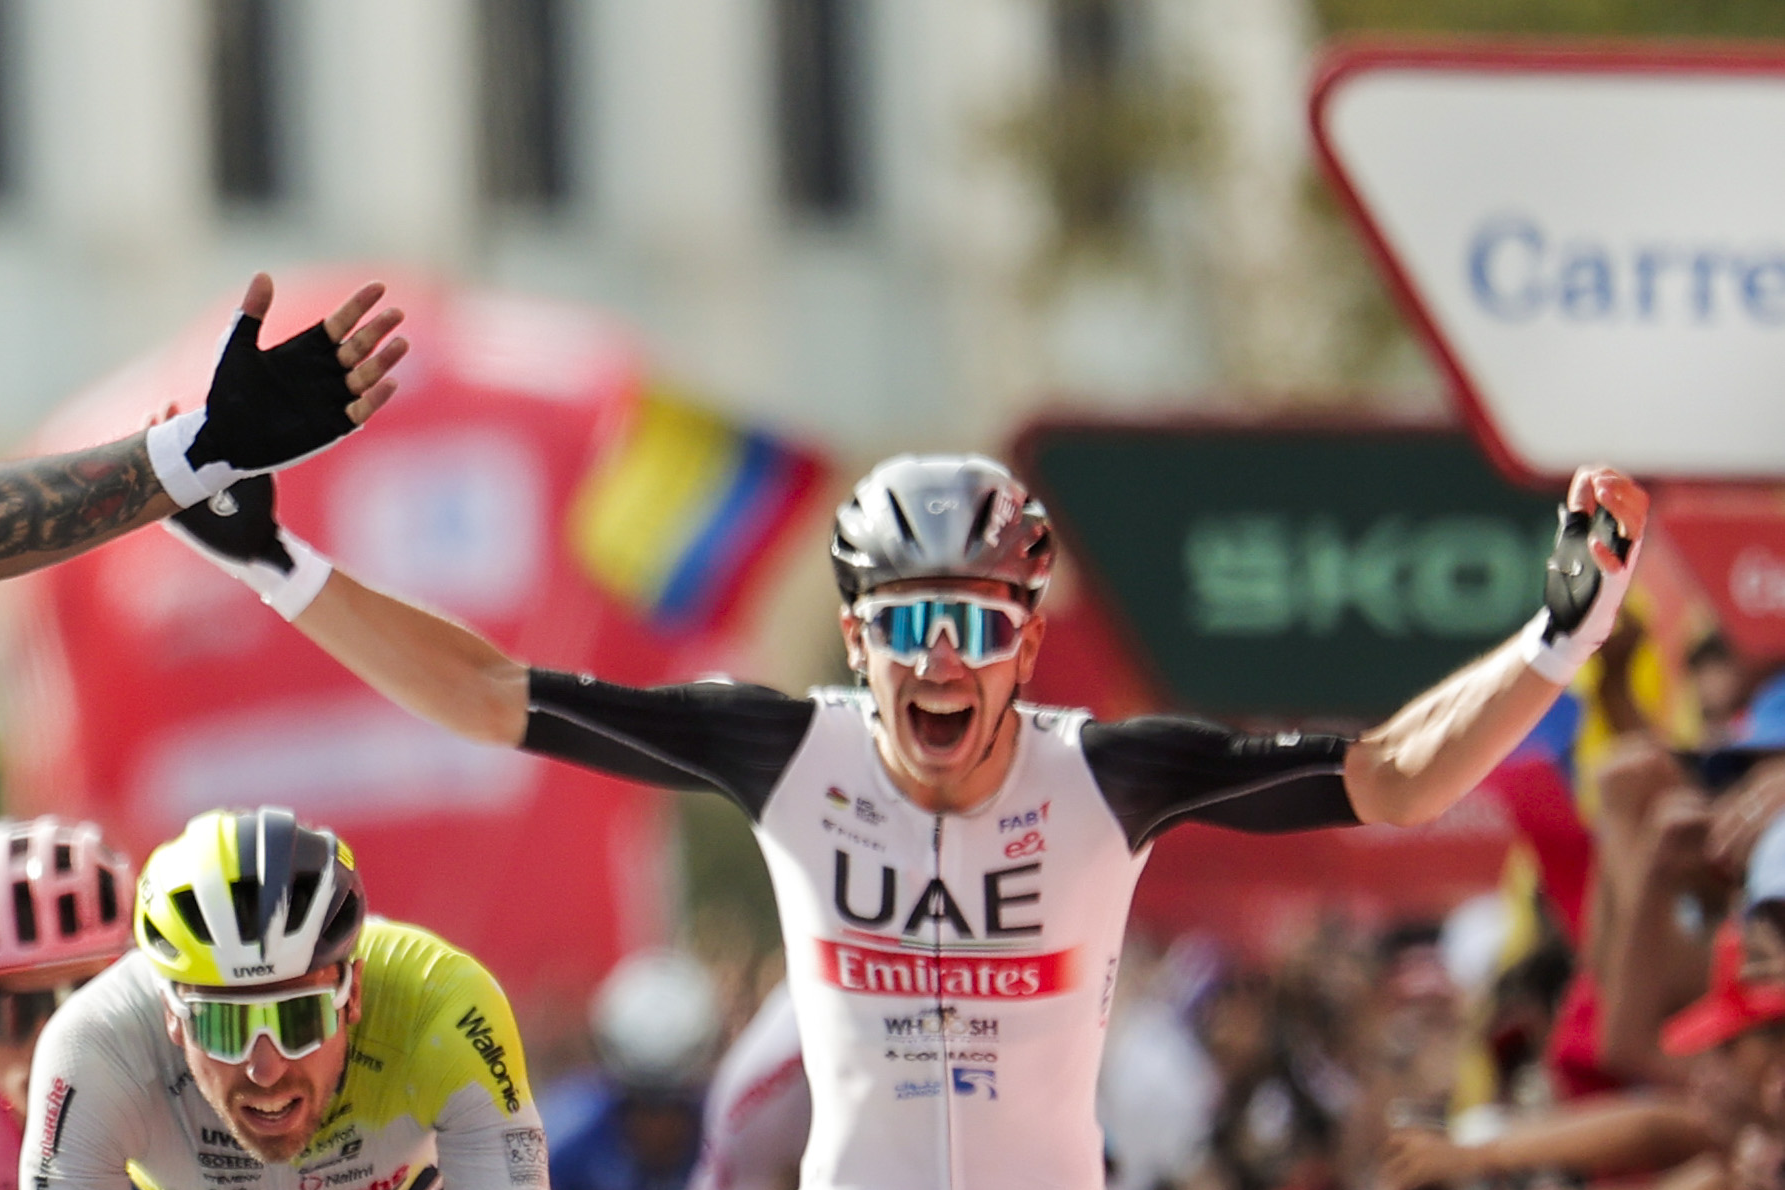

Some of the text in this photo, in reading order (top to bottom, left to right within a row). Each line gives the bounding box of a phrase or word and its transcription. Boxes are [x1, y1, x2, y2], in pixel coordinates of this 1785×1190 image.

[834, 848, 1044, 940] UAE
[232, 963, 276, 979] uvex
[835, 948, 1041, 997] Emirates
[883, 1017, 999, 1036] WHOOSH
[455, 1005, 520, 1114] Wallonie
